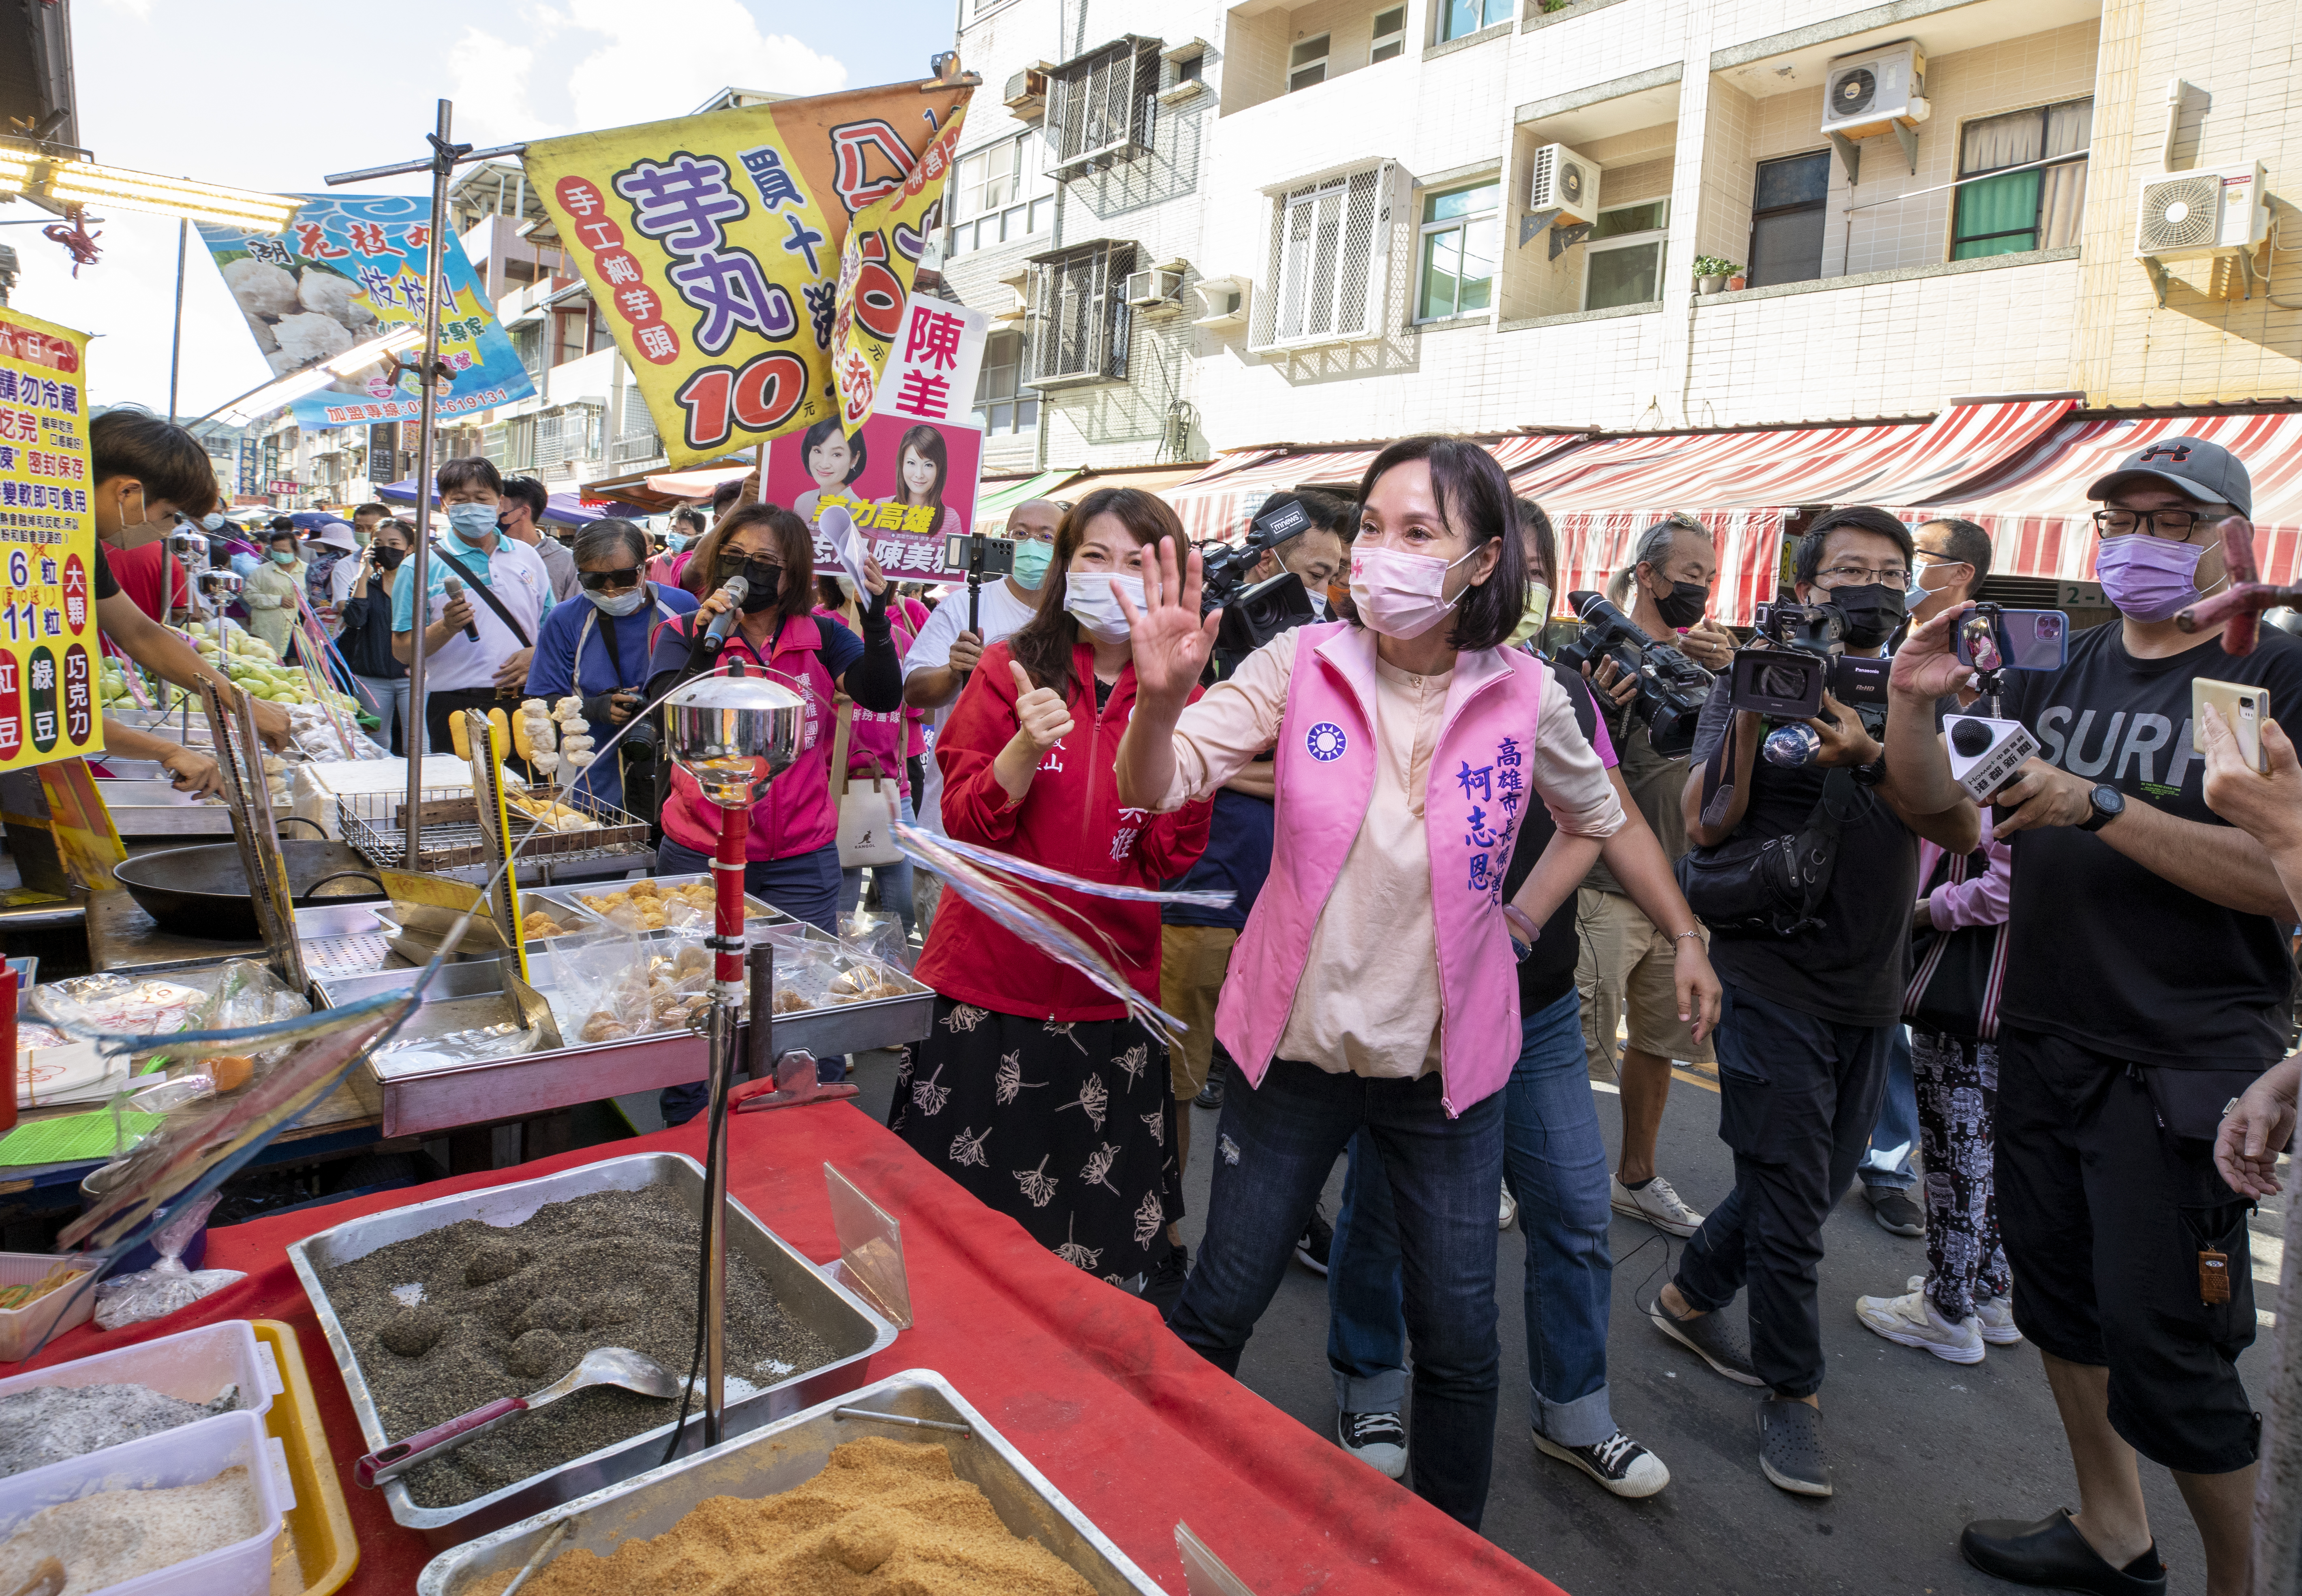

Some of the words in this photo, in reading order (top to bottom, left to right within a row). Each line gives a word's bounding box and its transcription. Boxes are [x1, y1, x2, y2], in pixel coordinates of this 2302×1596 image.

[2223, 175, 2251, 186] HITACHI
[563, 184, 678, 359] 手工純芋頭
[619, 156, 794, 349] 芋丸
[740, 147, 836, 352] 買十送
[0, 369, 78, 415] 請勿冷藏
[678, 353, 807, 447] 10
[28, 450, 84, 480] 密封保存
[1273, 514, 1300, 531] mnews
[10, 551, 27, 588] 6
[41, 558, 57, 584] 粒
[1242, 550, 1254, 558] SONY
[66, 564, 86, 625] 大顆
[3, 604, 34, 640] 11
[44, 609, 60, 635] 粒
[31, 659, 57, 742] 綠豆
[66, 654, 88, 736] 巧克力
[795, 673, 818, 718] 陳美雅
[804, 720, 818, 751] 團隊
[1973, 740, 2033, 794] 港都新聞
[1456, 760, 1497, 891] 柯志恩
